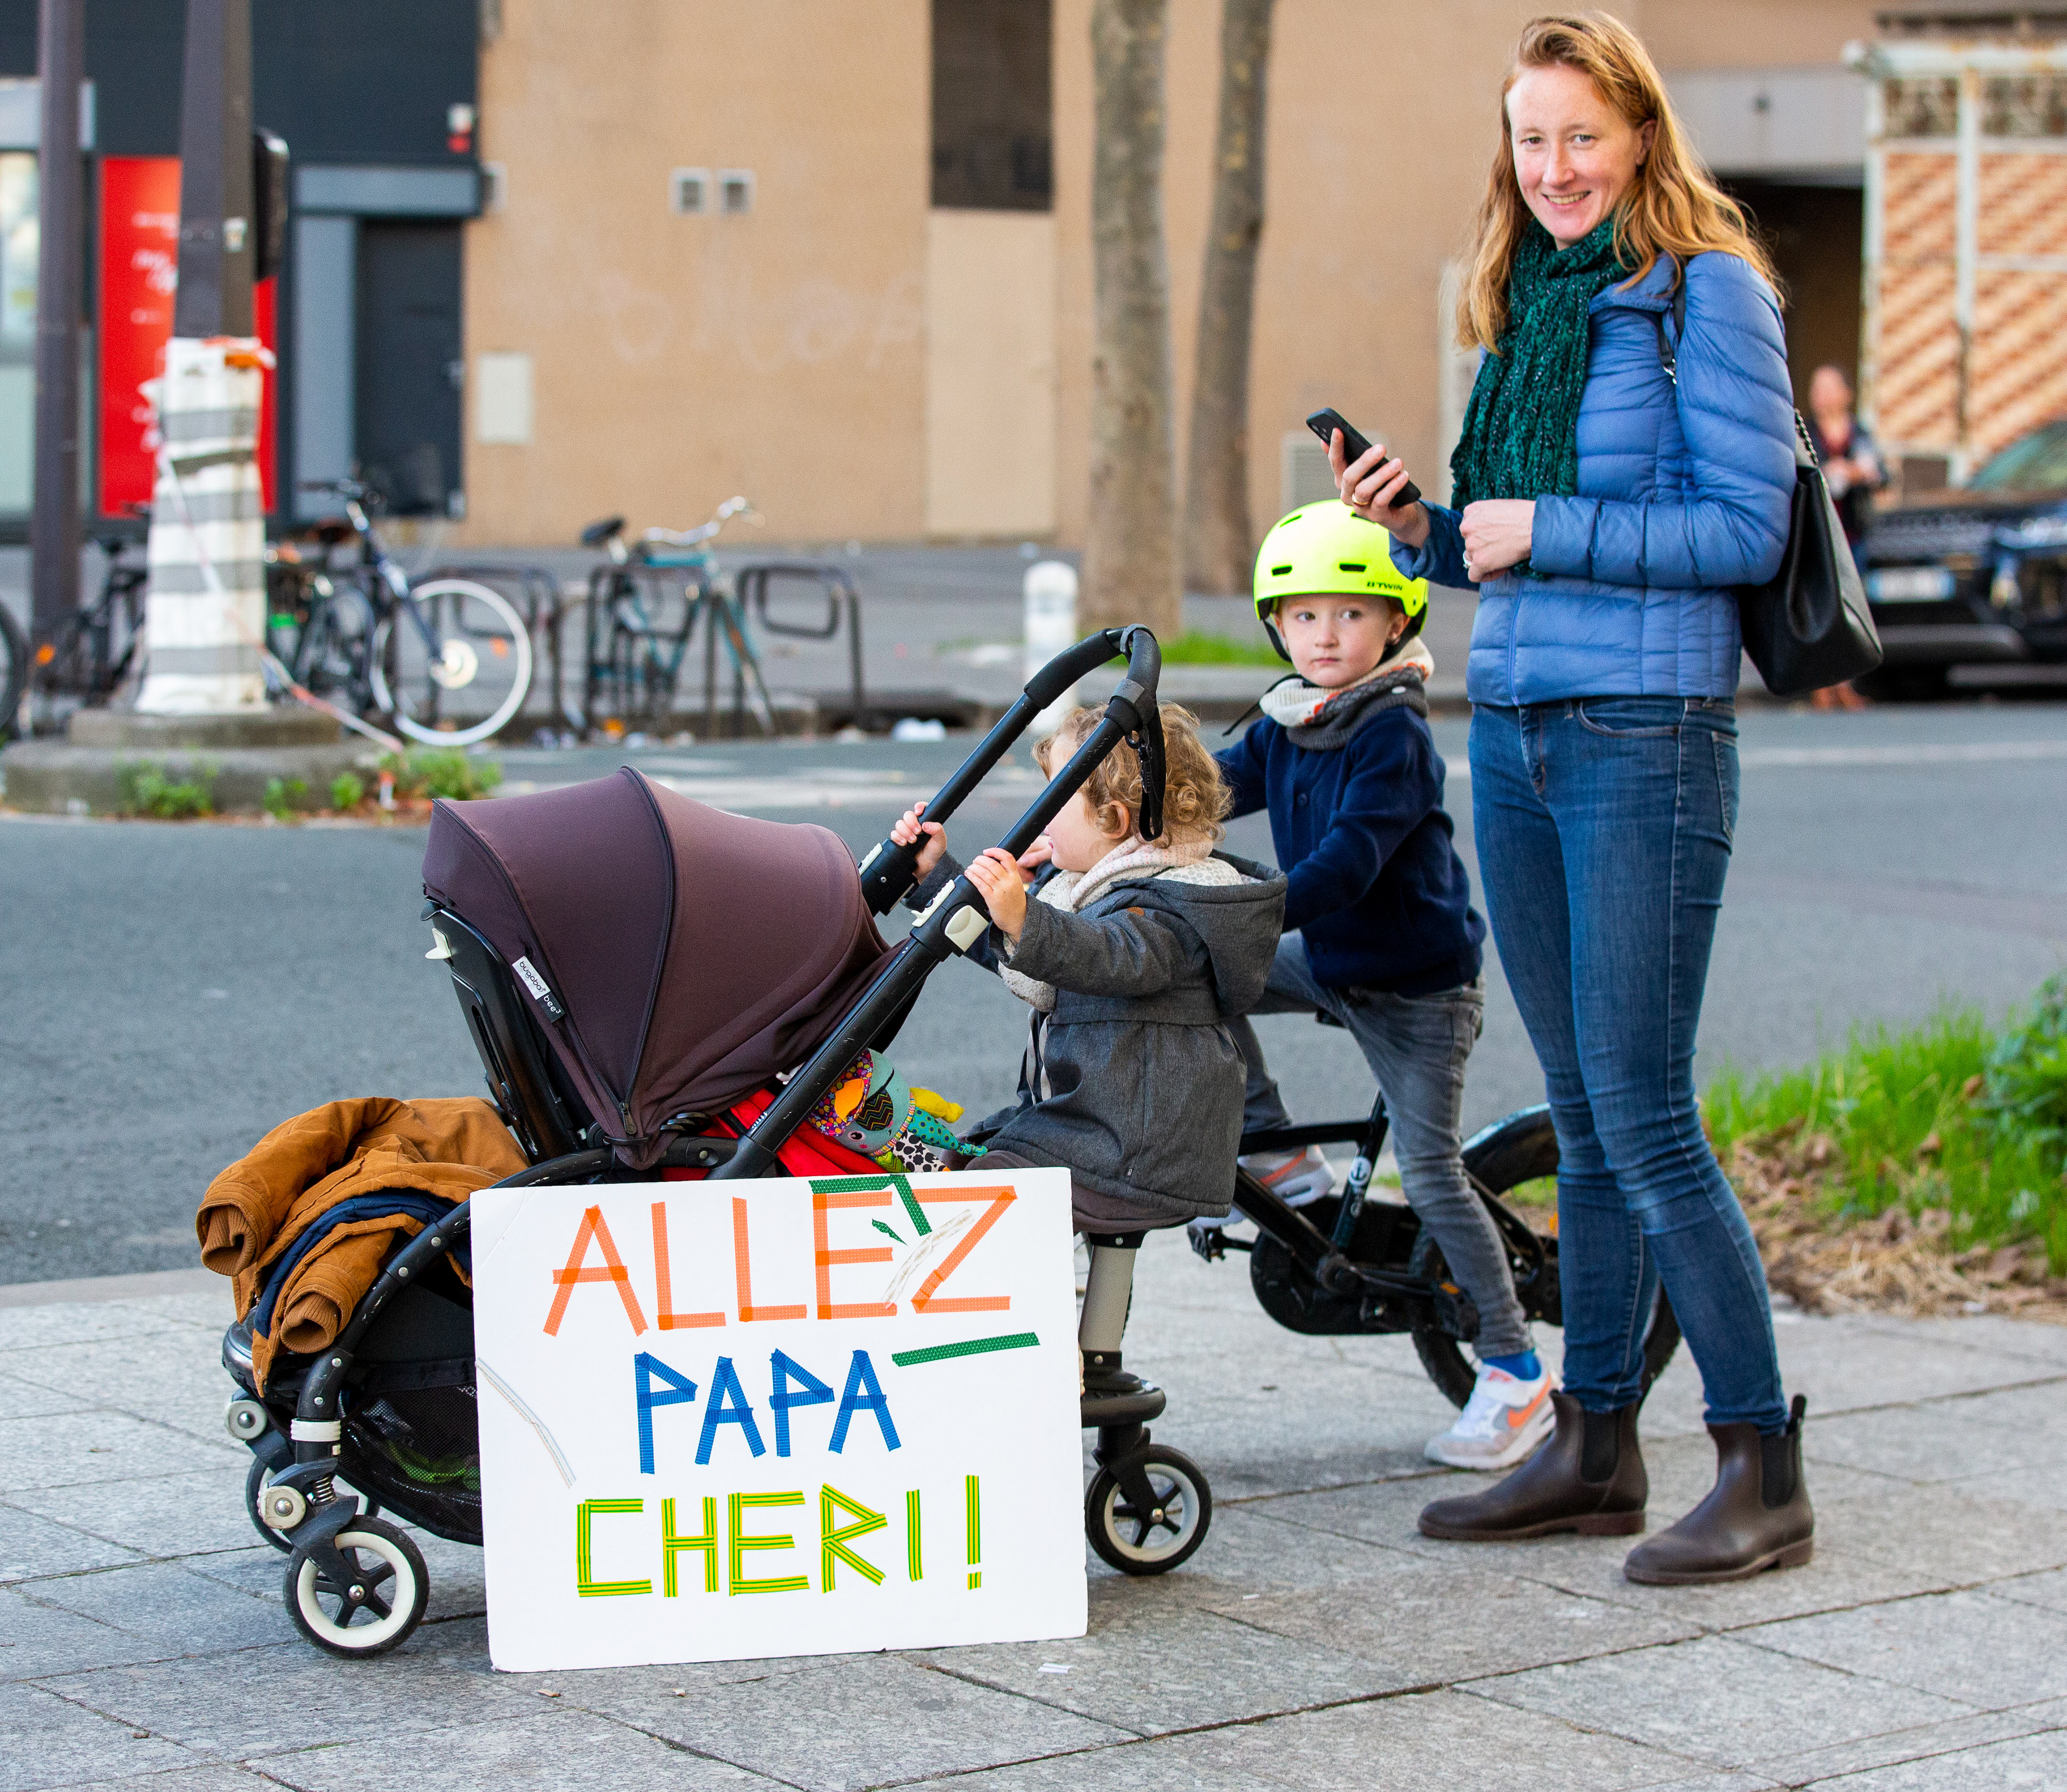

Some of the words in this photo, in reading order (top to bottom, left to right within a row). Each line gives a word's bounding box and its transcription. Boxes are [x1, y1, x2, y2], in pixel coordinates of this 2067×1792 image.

[543, 1185, 1018, 1337] ALLEZ
[634, 1349, 902, 1474] PAPA
[576, 1483, 923, 1598] CHERI
